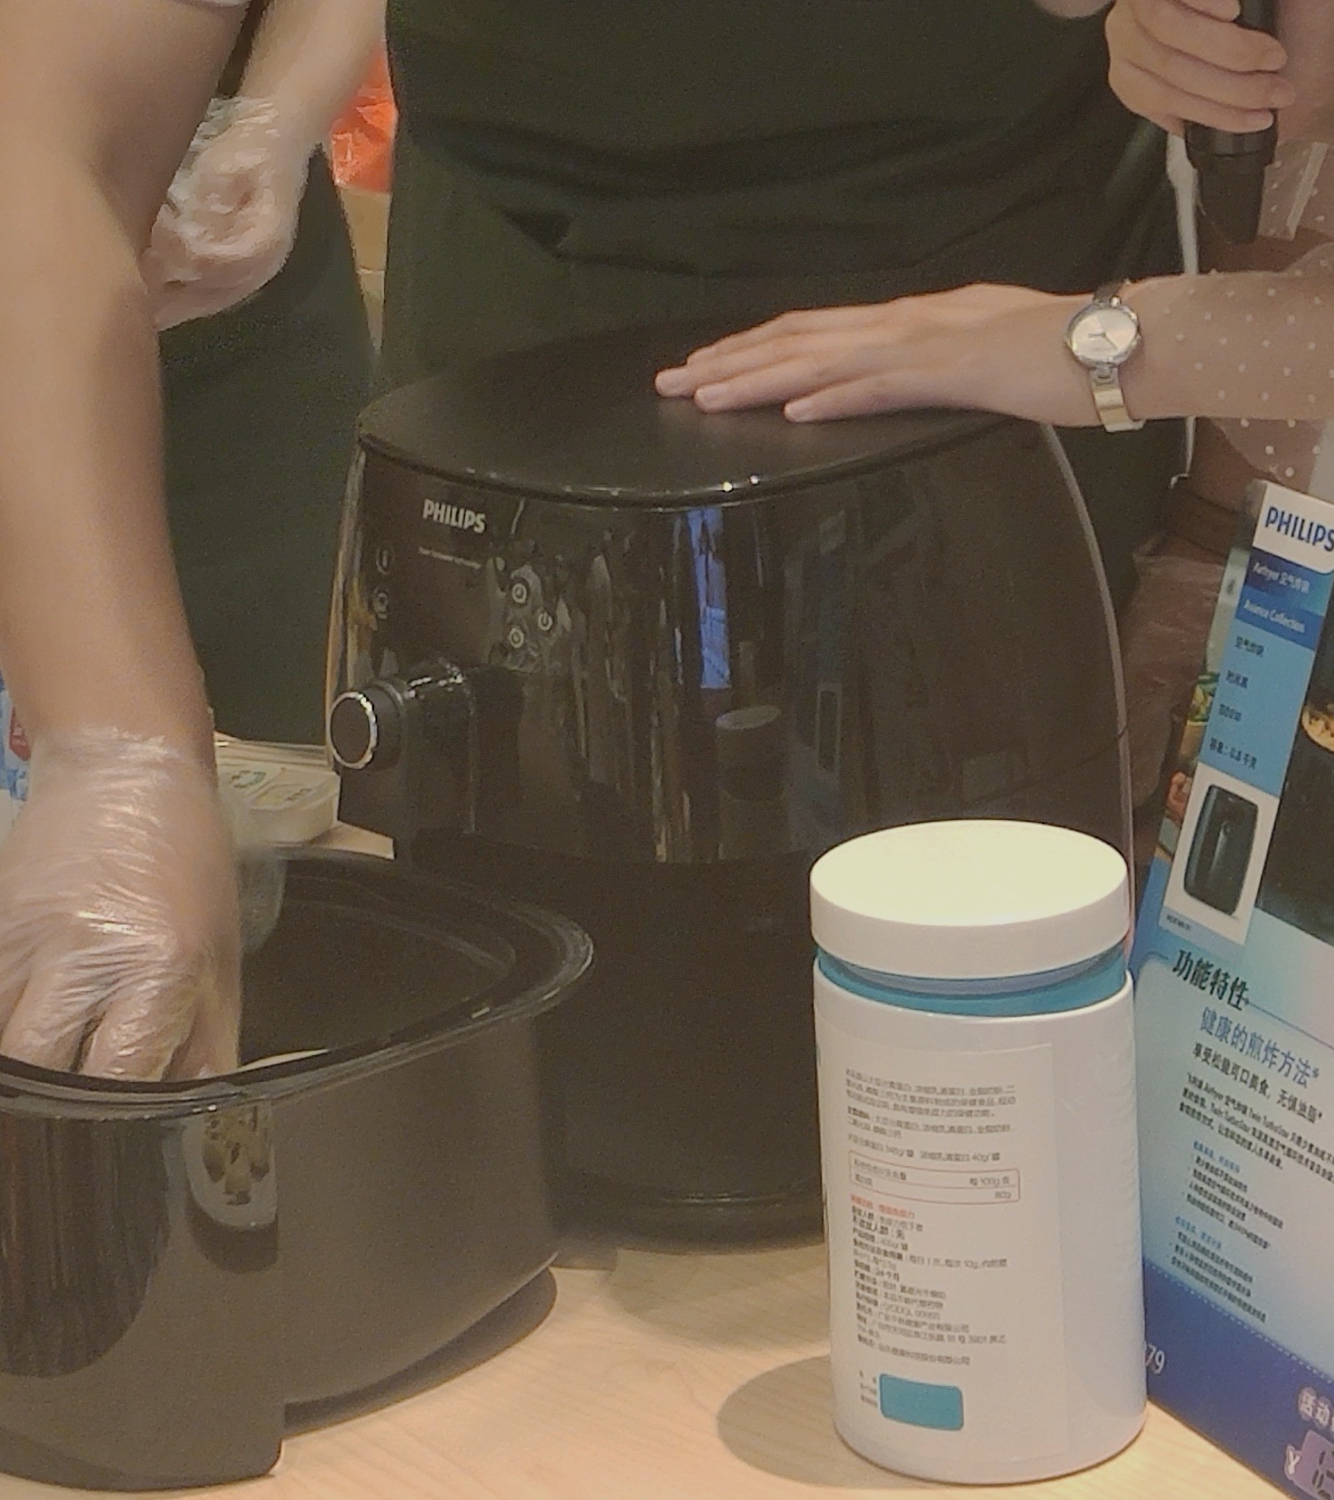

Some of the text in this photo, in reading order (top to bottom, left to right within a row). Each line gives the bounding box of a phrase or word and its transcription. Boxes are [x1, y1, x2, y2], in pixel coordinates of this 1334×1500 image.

[423, 499, 486, 534] PHILIPS
[1172, 949, 1249, 1012] 功能特性
